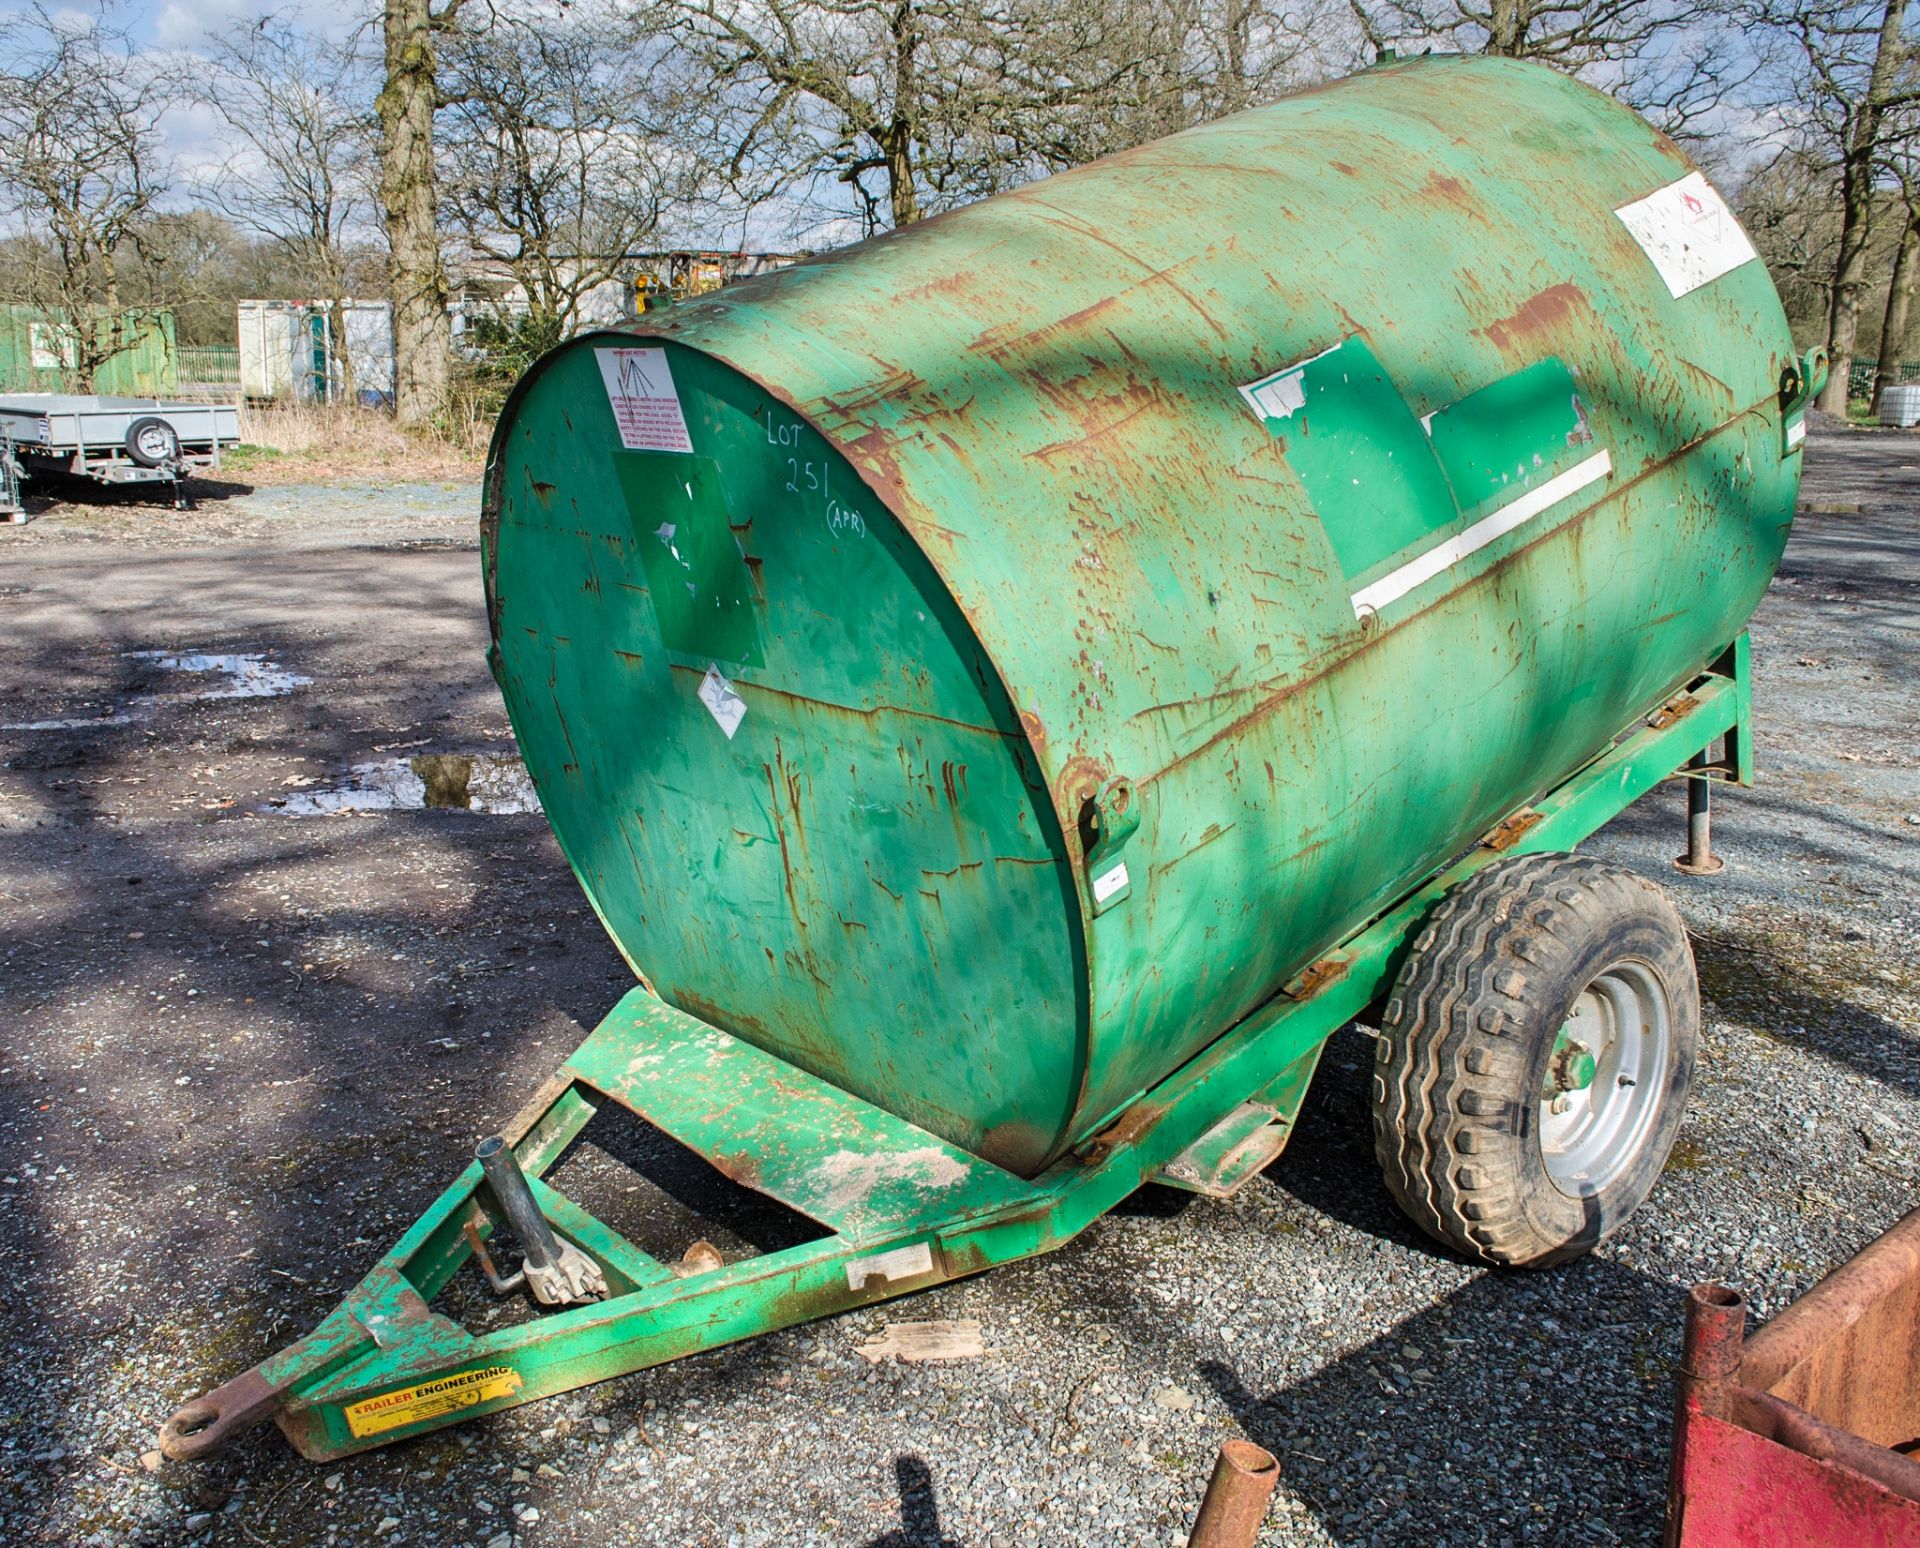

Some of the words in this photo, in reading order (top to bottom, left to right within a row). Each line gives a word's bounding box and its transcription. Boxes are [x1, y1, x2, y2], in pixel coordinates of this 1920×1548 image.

[767, 410, 804, 448] LOT
[785, 457, 828, 498] 251
[826, 500, 866, 539] (APR)
[416, 1366, 509, 1398] ENGINEERING
